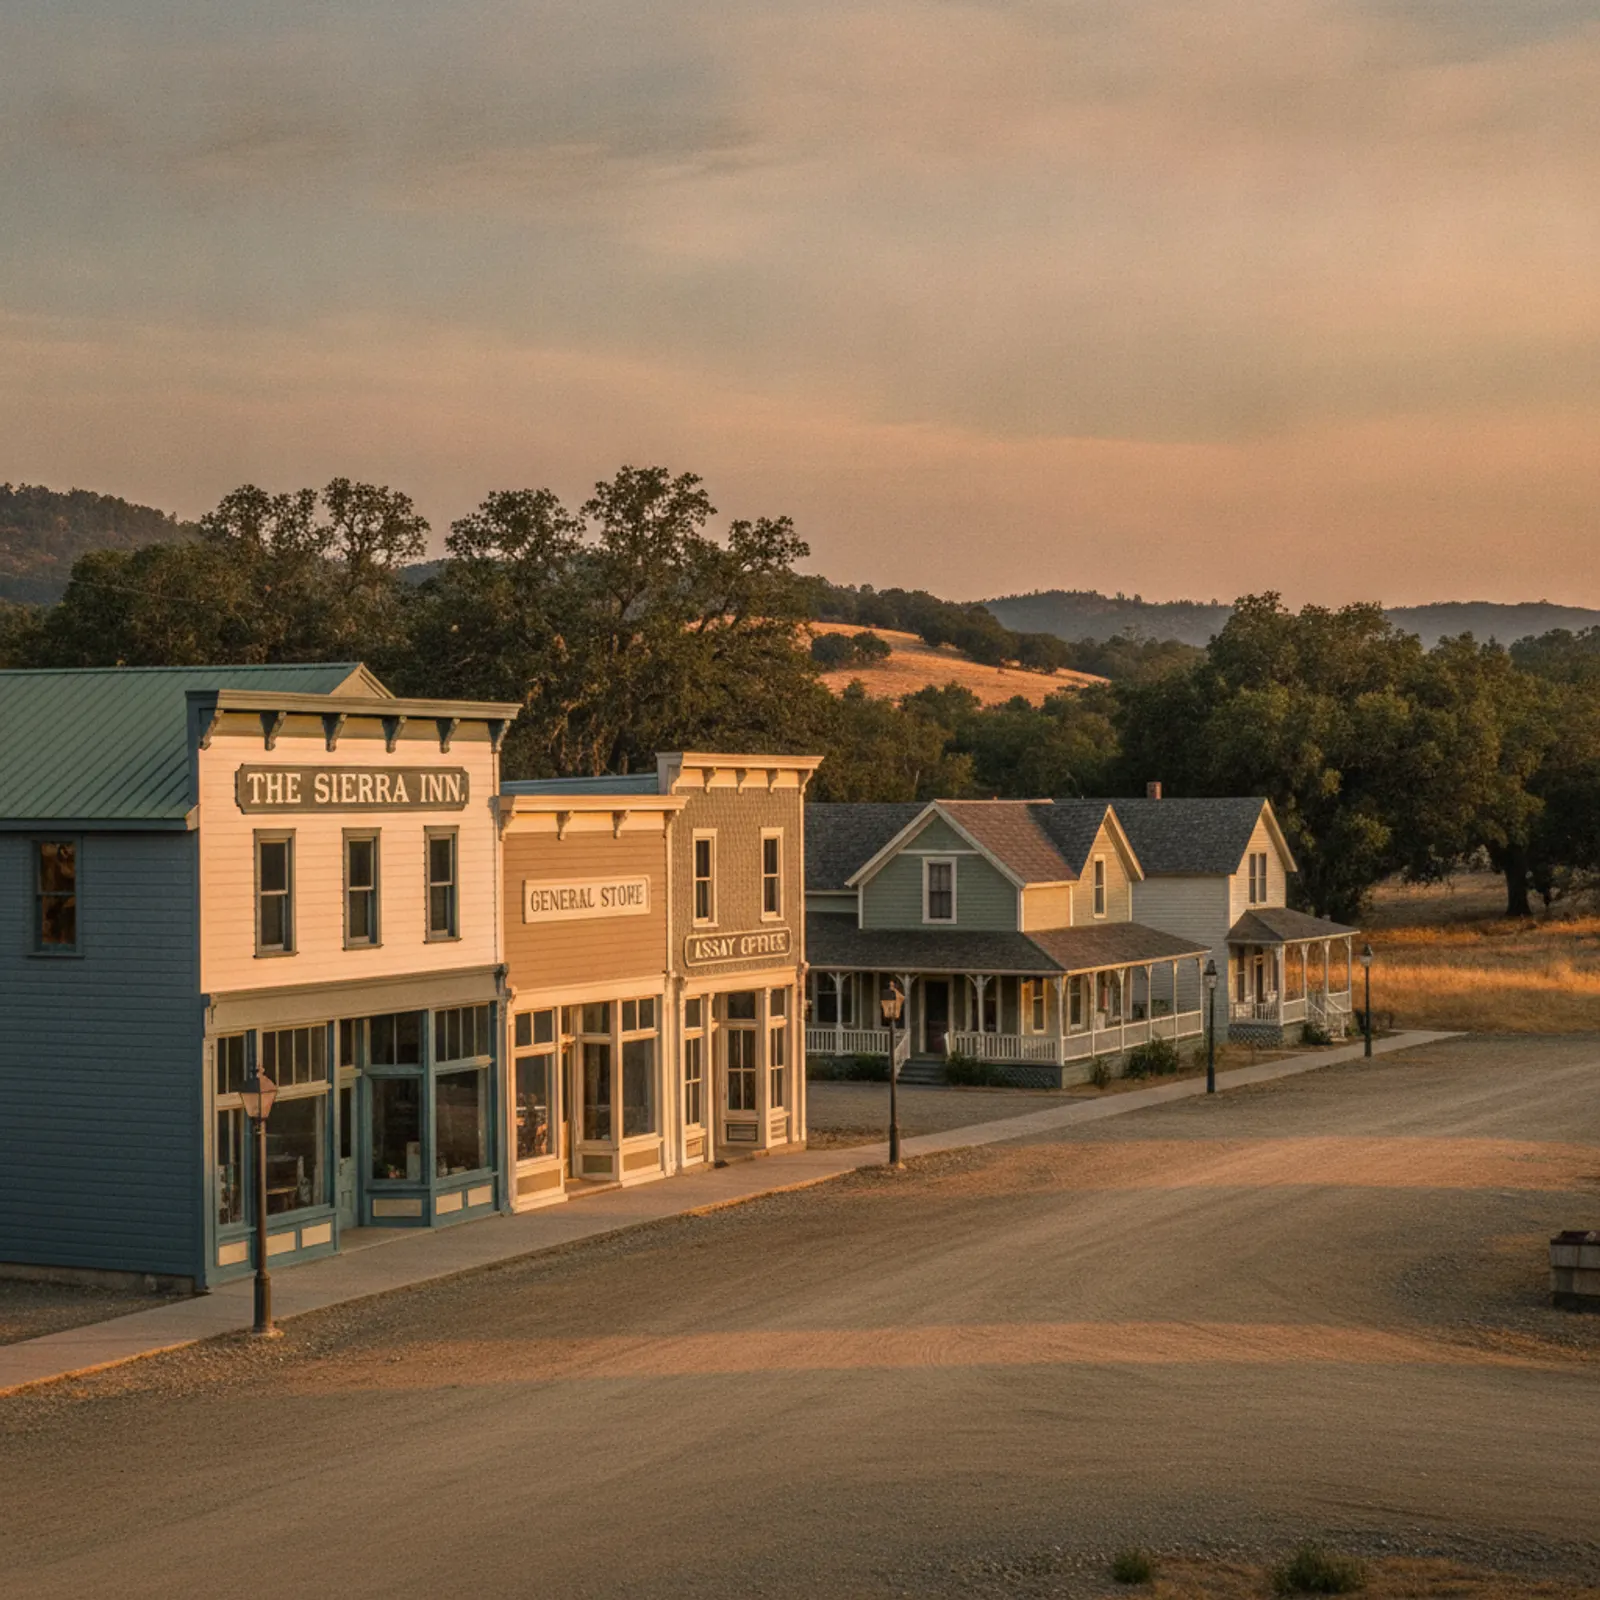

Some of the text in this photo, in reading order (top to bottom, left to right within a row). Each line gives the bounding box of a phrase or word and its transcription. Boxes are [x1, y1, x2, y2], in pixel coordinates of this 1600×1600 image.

[247, 772, 301, 804] THE
[314, 773, 410, 803] SIERRA
[530, 888, 596, 912] GENERAL
[695, 937, 736, 959] ASSAY
